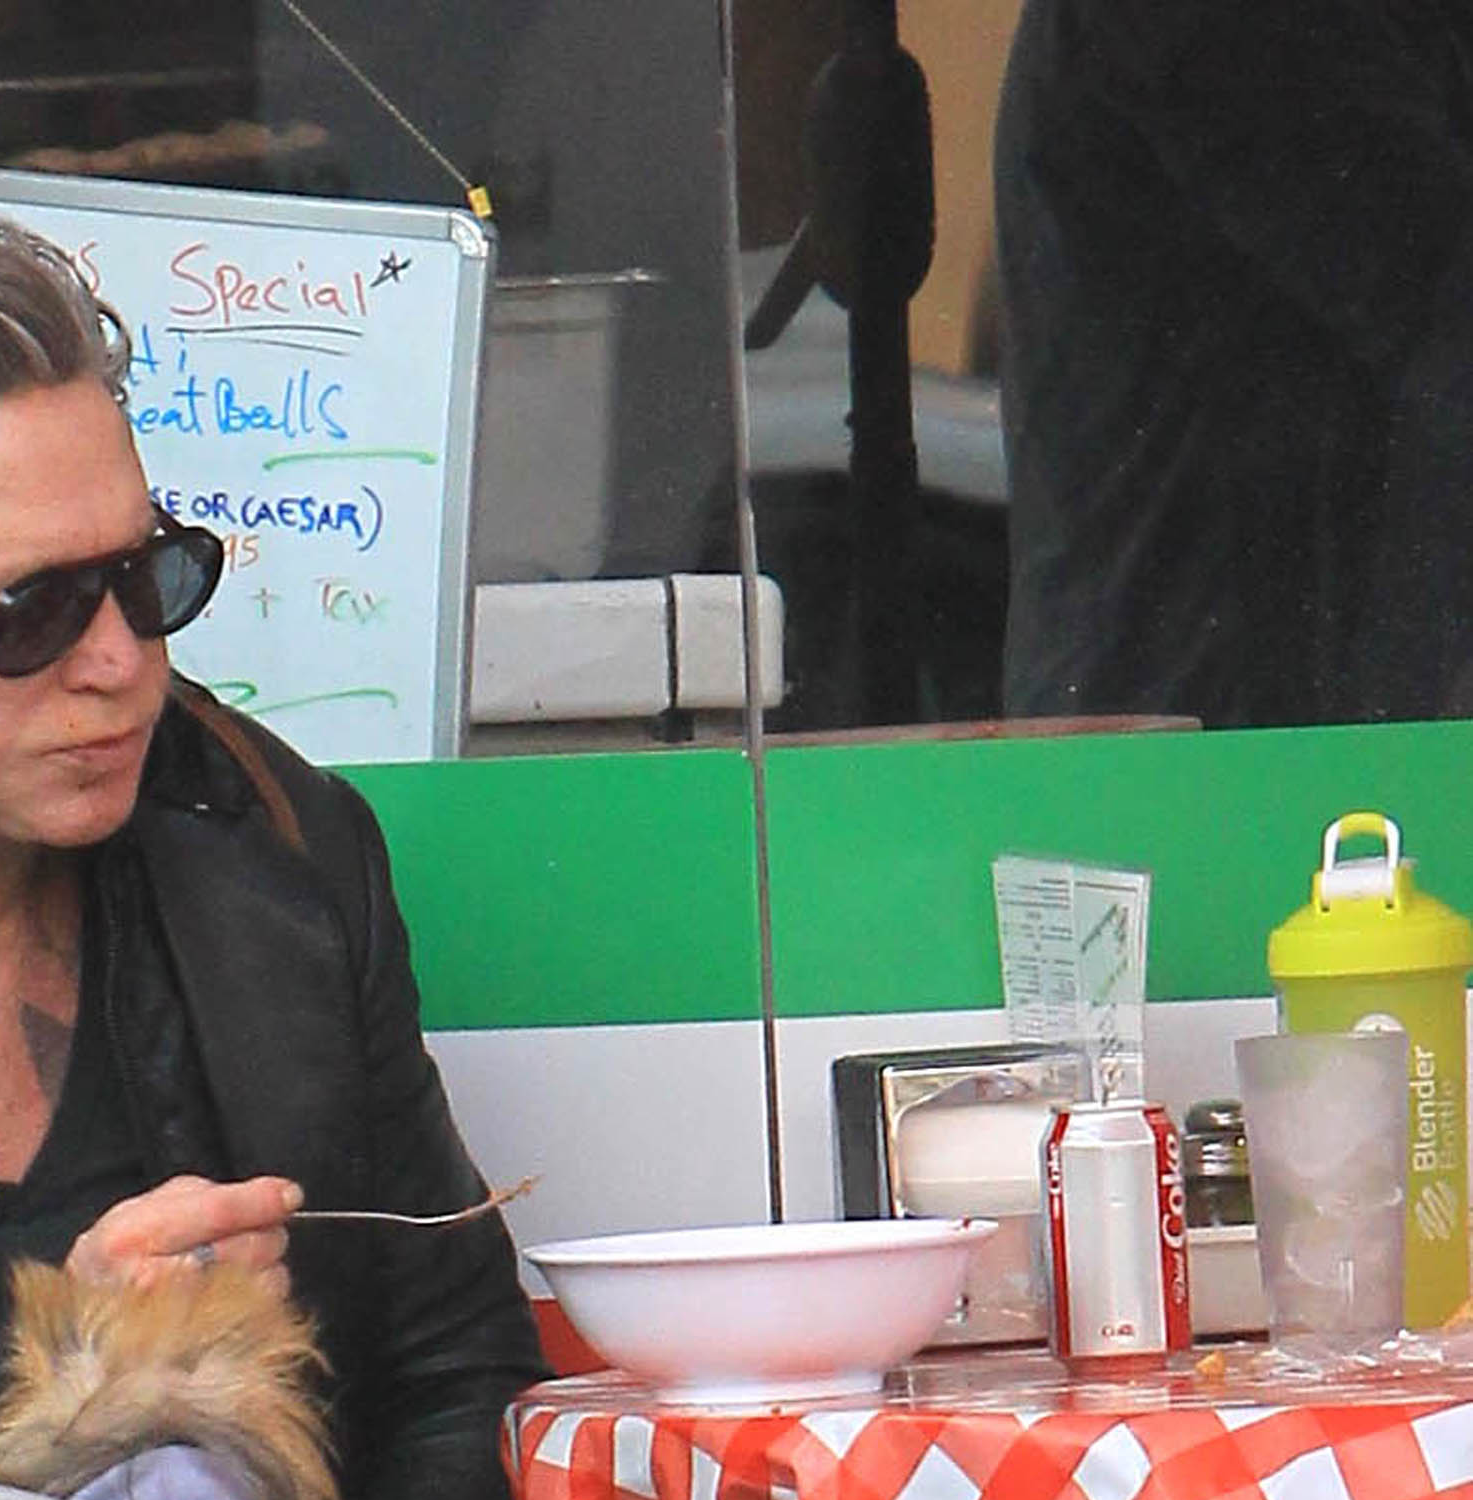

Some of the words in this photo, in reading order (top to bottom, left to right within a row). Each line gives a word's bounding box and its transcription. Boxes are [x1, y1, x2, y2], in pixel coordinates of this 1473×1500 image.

[169, 242, 368, 326] Special
[128, 374, 207, 437] eat
[190, 492, 238, 525] OR
[1408, 1045, 1437, 1172] Blender
[1161, 1132, 1187, 1249] Coke
